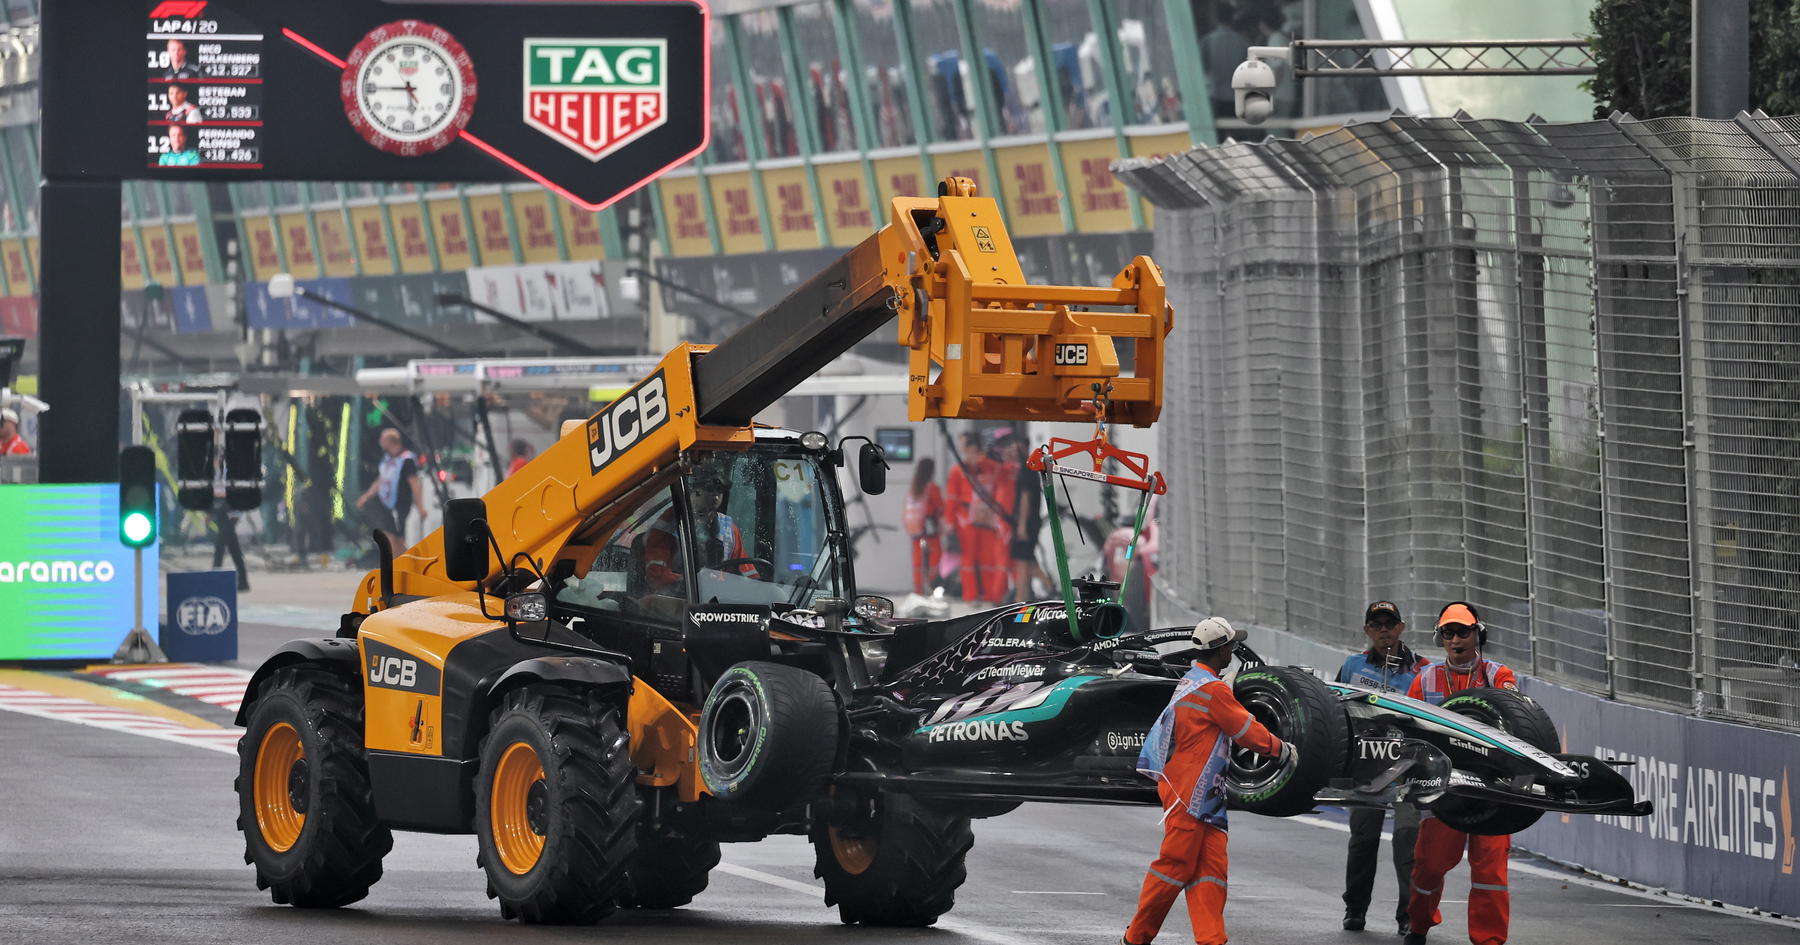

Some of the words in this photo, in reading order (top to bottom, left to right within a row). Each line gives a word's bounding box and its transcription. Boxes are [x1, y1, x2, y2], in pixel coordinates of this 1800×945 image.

[198, 44, 222, 54] NICO
[147, 51, 170, 68] 10
[536, 47, 653, 84] TAG
[198, 87, 246, 97] ESTEBAN
[147, 94, 170, 111] 11
[198, 97, 228, 106] OCON
[533, 94, 657, 149] HEUER
[198, 129, 255, 139] FERNANDO
[147, 136, 171, 153] 12
[198, 139, 241, 149] ALONSO
[1056, 345, 1087, 365] JCB
[591, 377, 667, 467] JCB
[0, 560, 114, 582] aramco
[694, 612, 759, 624] CROWDSTRIKE
[1033, 607, 1083, 621] Microst
[987, 638, 1026, 648] SOLERA
[1093, 640, 1112, 652] AMD
[370, 656, 417, 687] JCB
[988, 664, 1046, 677] TeamViewer
[929, 720, 1029, 742] PETRONAS
[1360, 740, 1401, 760] IWC
[1449, 737, 1489, 756] Einhell
[1684, 766, 1776, 860] AIRLINES
